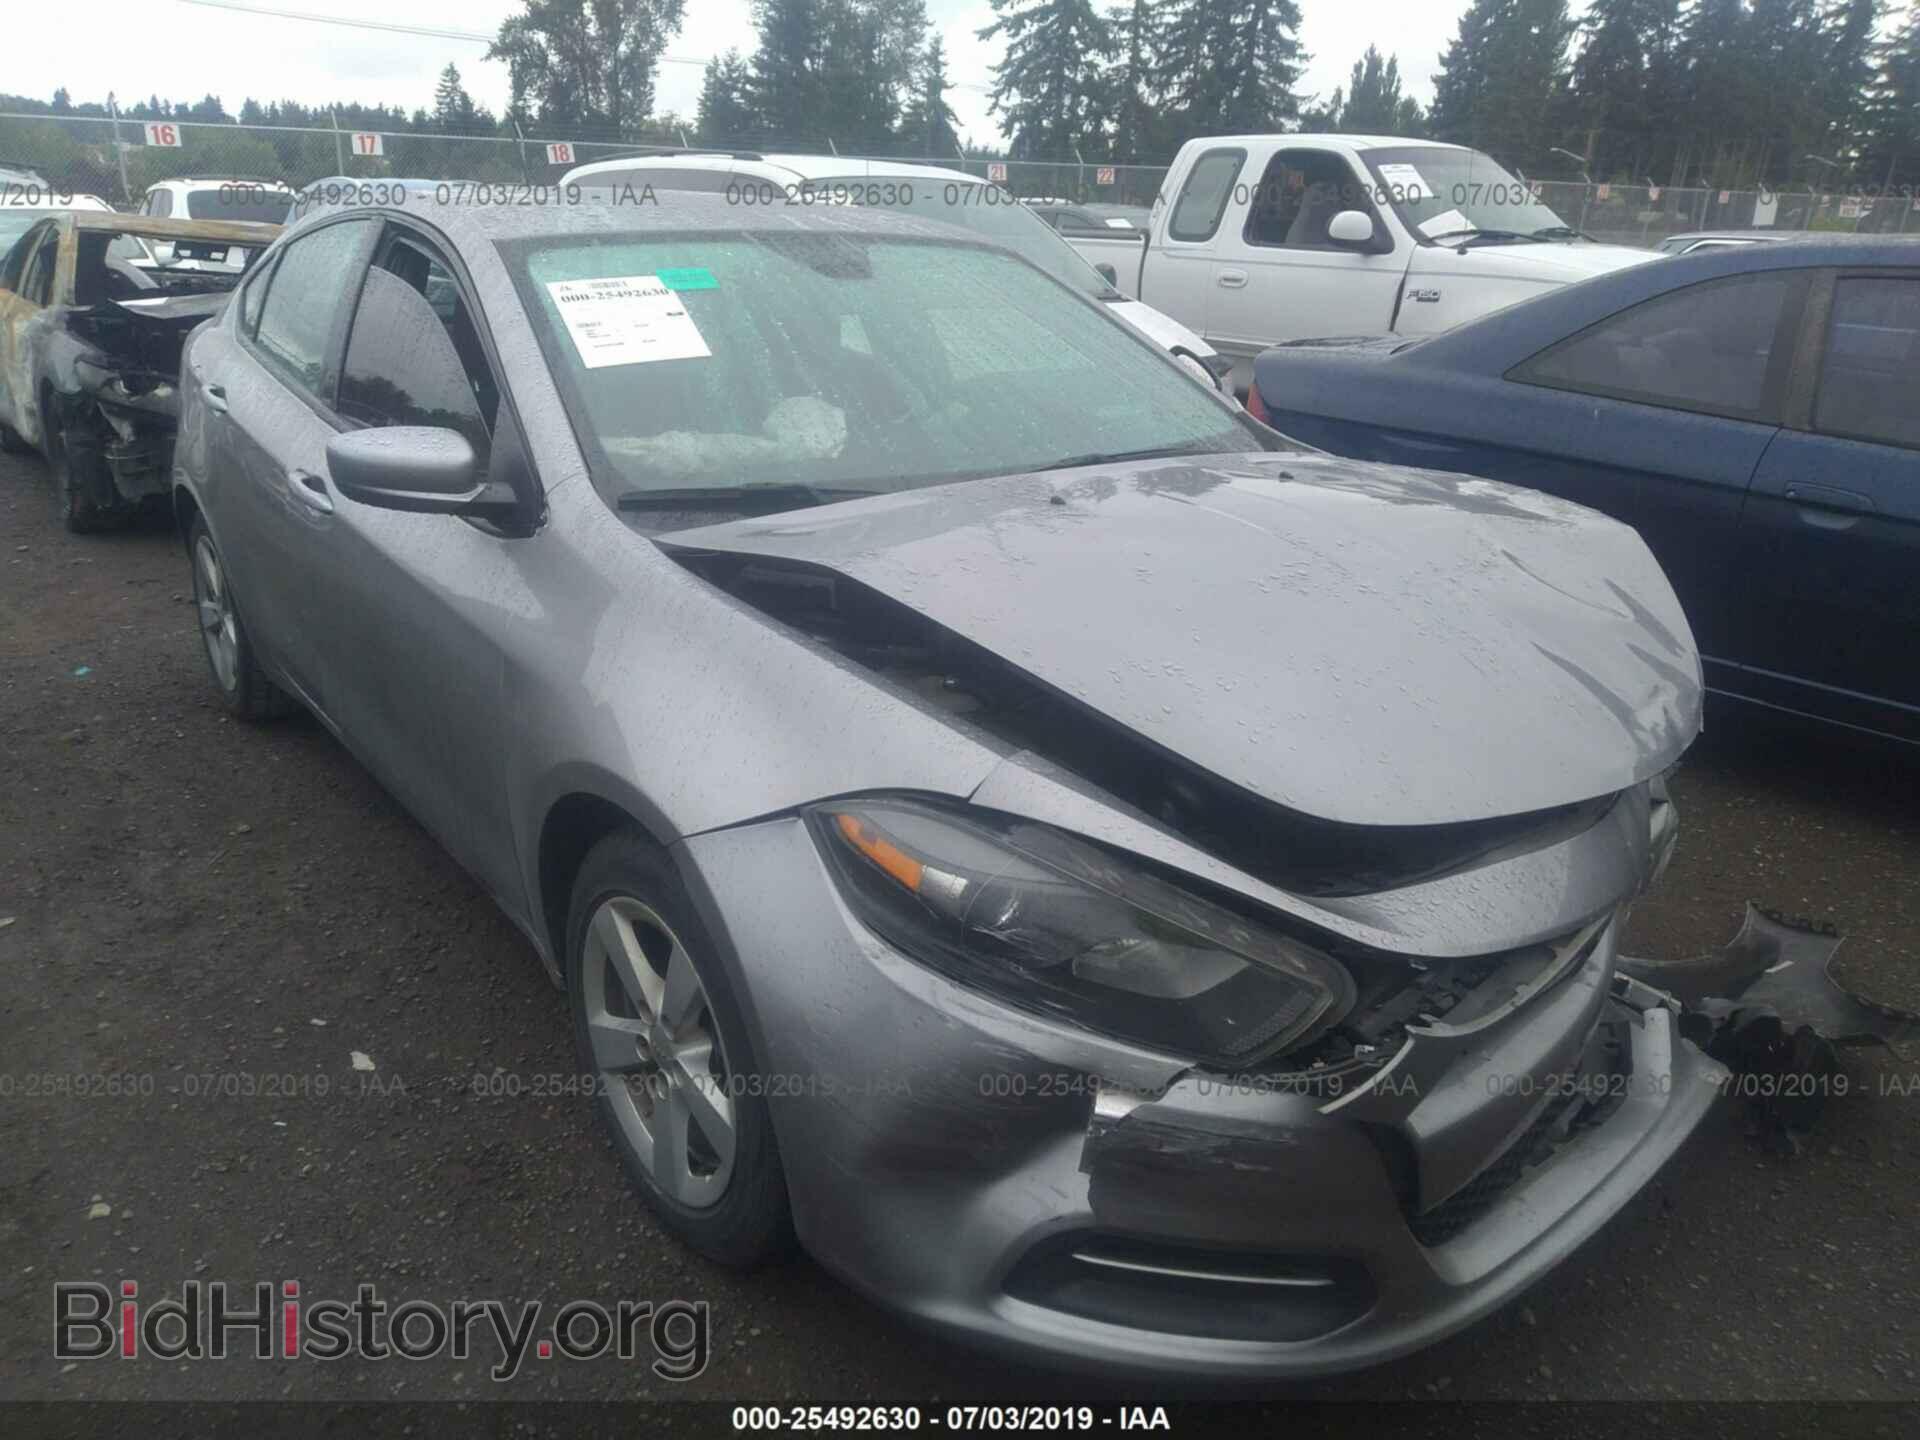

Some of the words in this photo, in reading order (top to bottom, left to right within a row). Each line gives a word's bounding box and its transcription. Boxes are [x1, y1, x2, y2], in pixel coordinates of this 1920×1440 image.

[150, 125, 177, 145] 16
[357, 134, 376, 153] 17
[550, 144, 570, 162] 18
[991, 165, 1004, 178] 21
[1099, 169, 1113, 183] 22
[560, 288, 670, 304] 000-25492630
